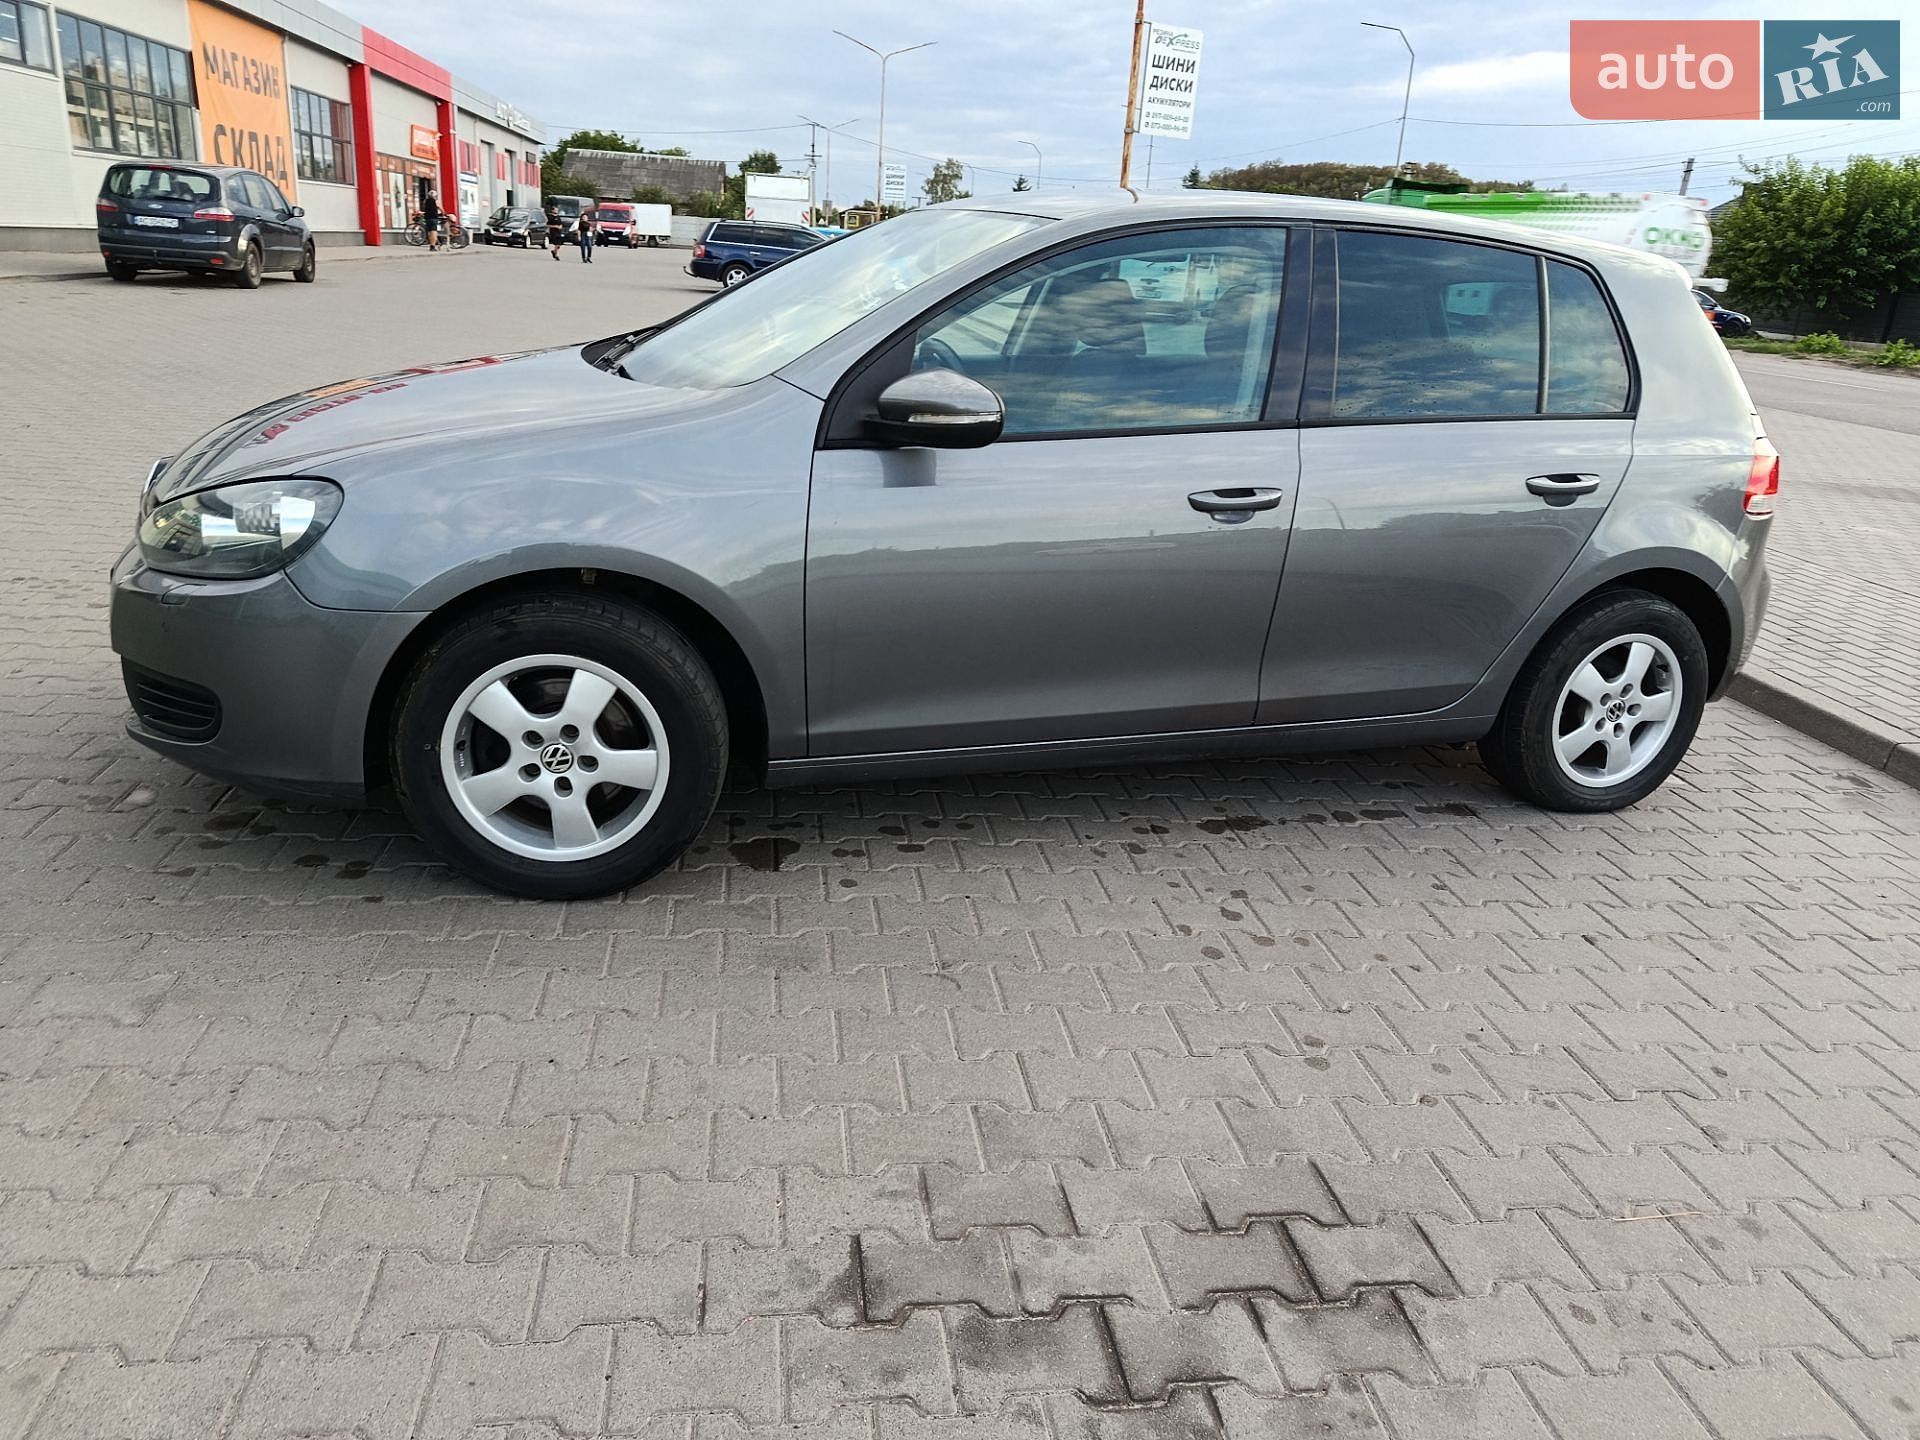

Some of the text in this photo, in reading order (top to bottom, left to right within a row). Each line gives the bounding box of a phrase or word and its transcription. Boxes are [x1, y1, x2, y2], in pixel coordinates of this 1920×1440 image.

[202, 42, 281, 99] МАГАЗИН
[1151, 54, 1196, 74] ШИНИ
[1148, 75, 1194, 93] ДИСКИ
[213, 124, 289, 190] СКЛАД
